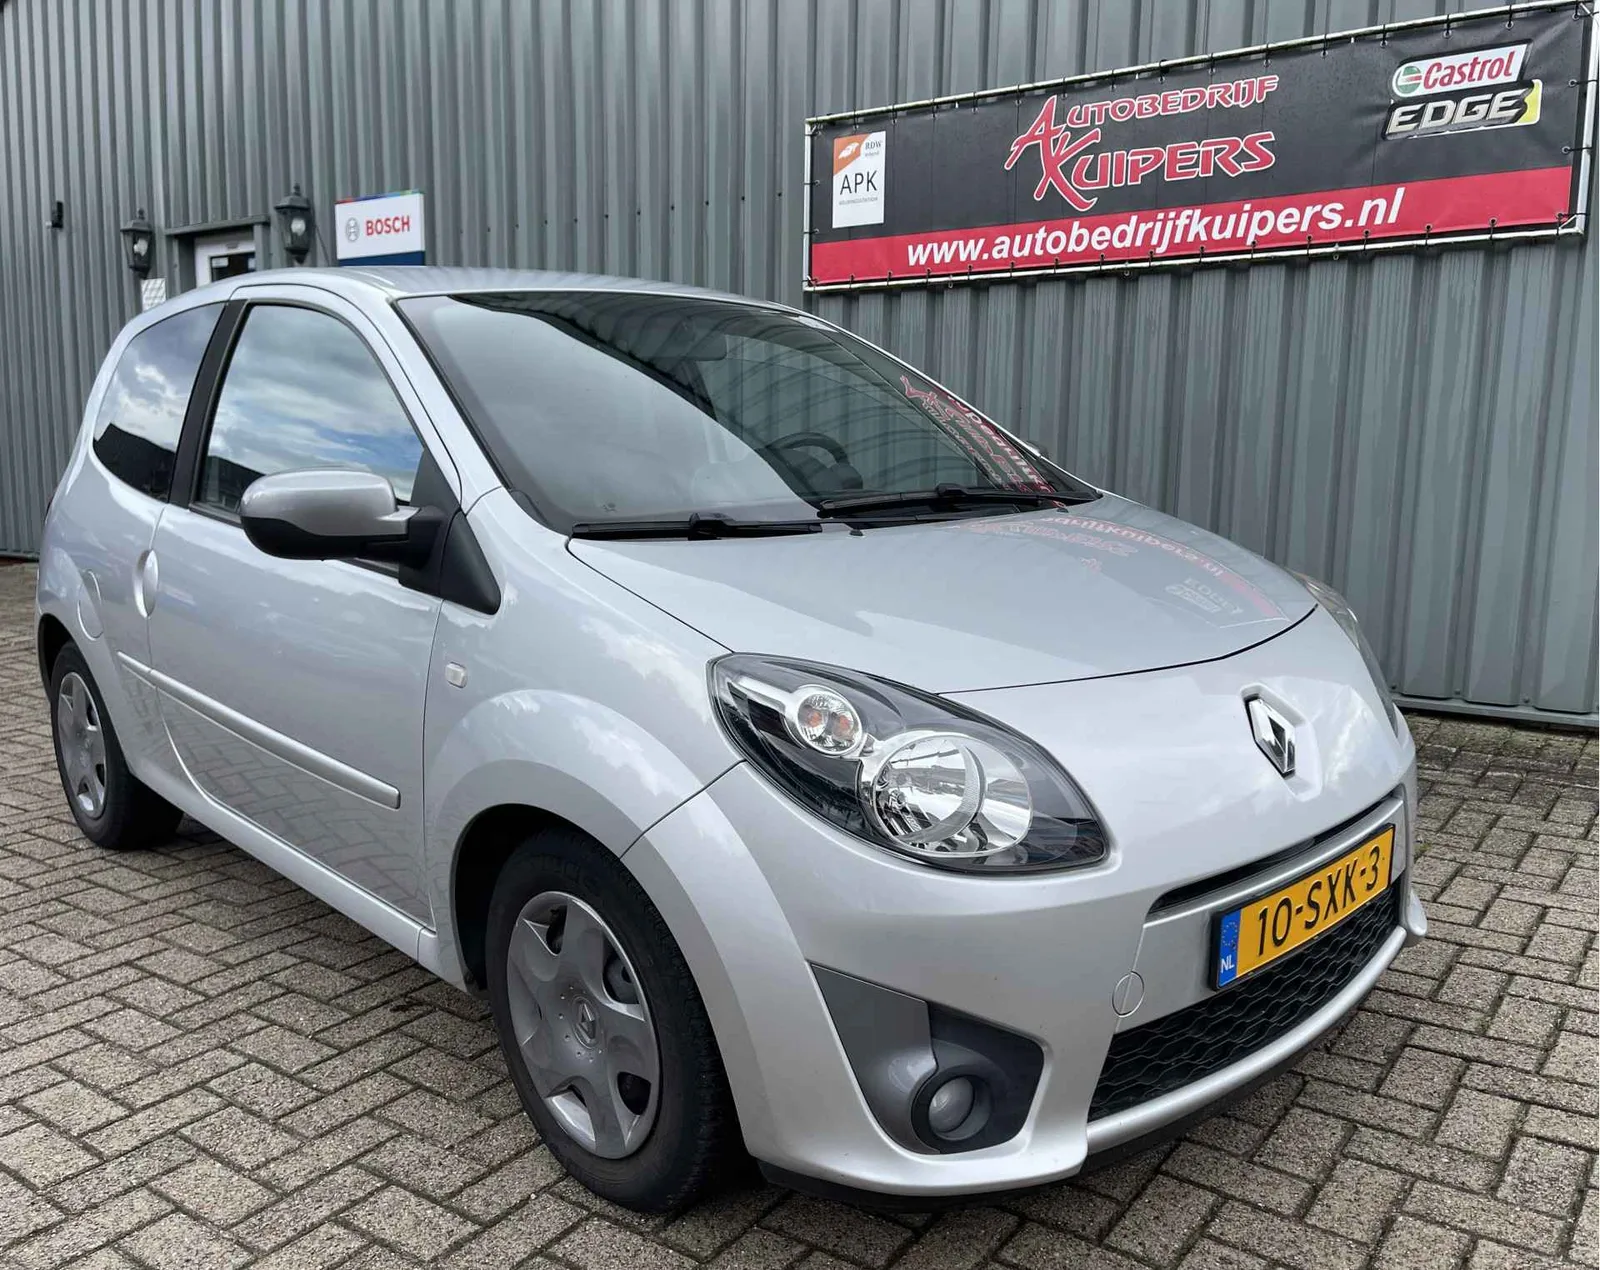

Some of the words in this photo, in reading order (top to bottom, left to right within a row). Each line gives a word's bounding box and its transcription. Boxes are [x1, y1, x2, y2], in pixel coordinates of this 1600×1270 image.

[1424, 51, 1515, 90] Castrol
[1005, 76, 1279, 169] AUTOBEDRIJF
[1386, 88, 1530, 135] EDGE
[840, 170, 877, 195] APK
[1034, 128, 1276, 211] KUIPERS
[365, 215, 410, 236] BOSCH
[907, 187, 1406, 268] www.autobedrijfkuipers.nl
[1258, 846, 1380, 957] 10-SXK-3
[1220, 955, 1235, 973] NL
